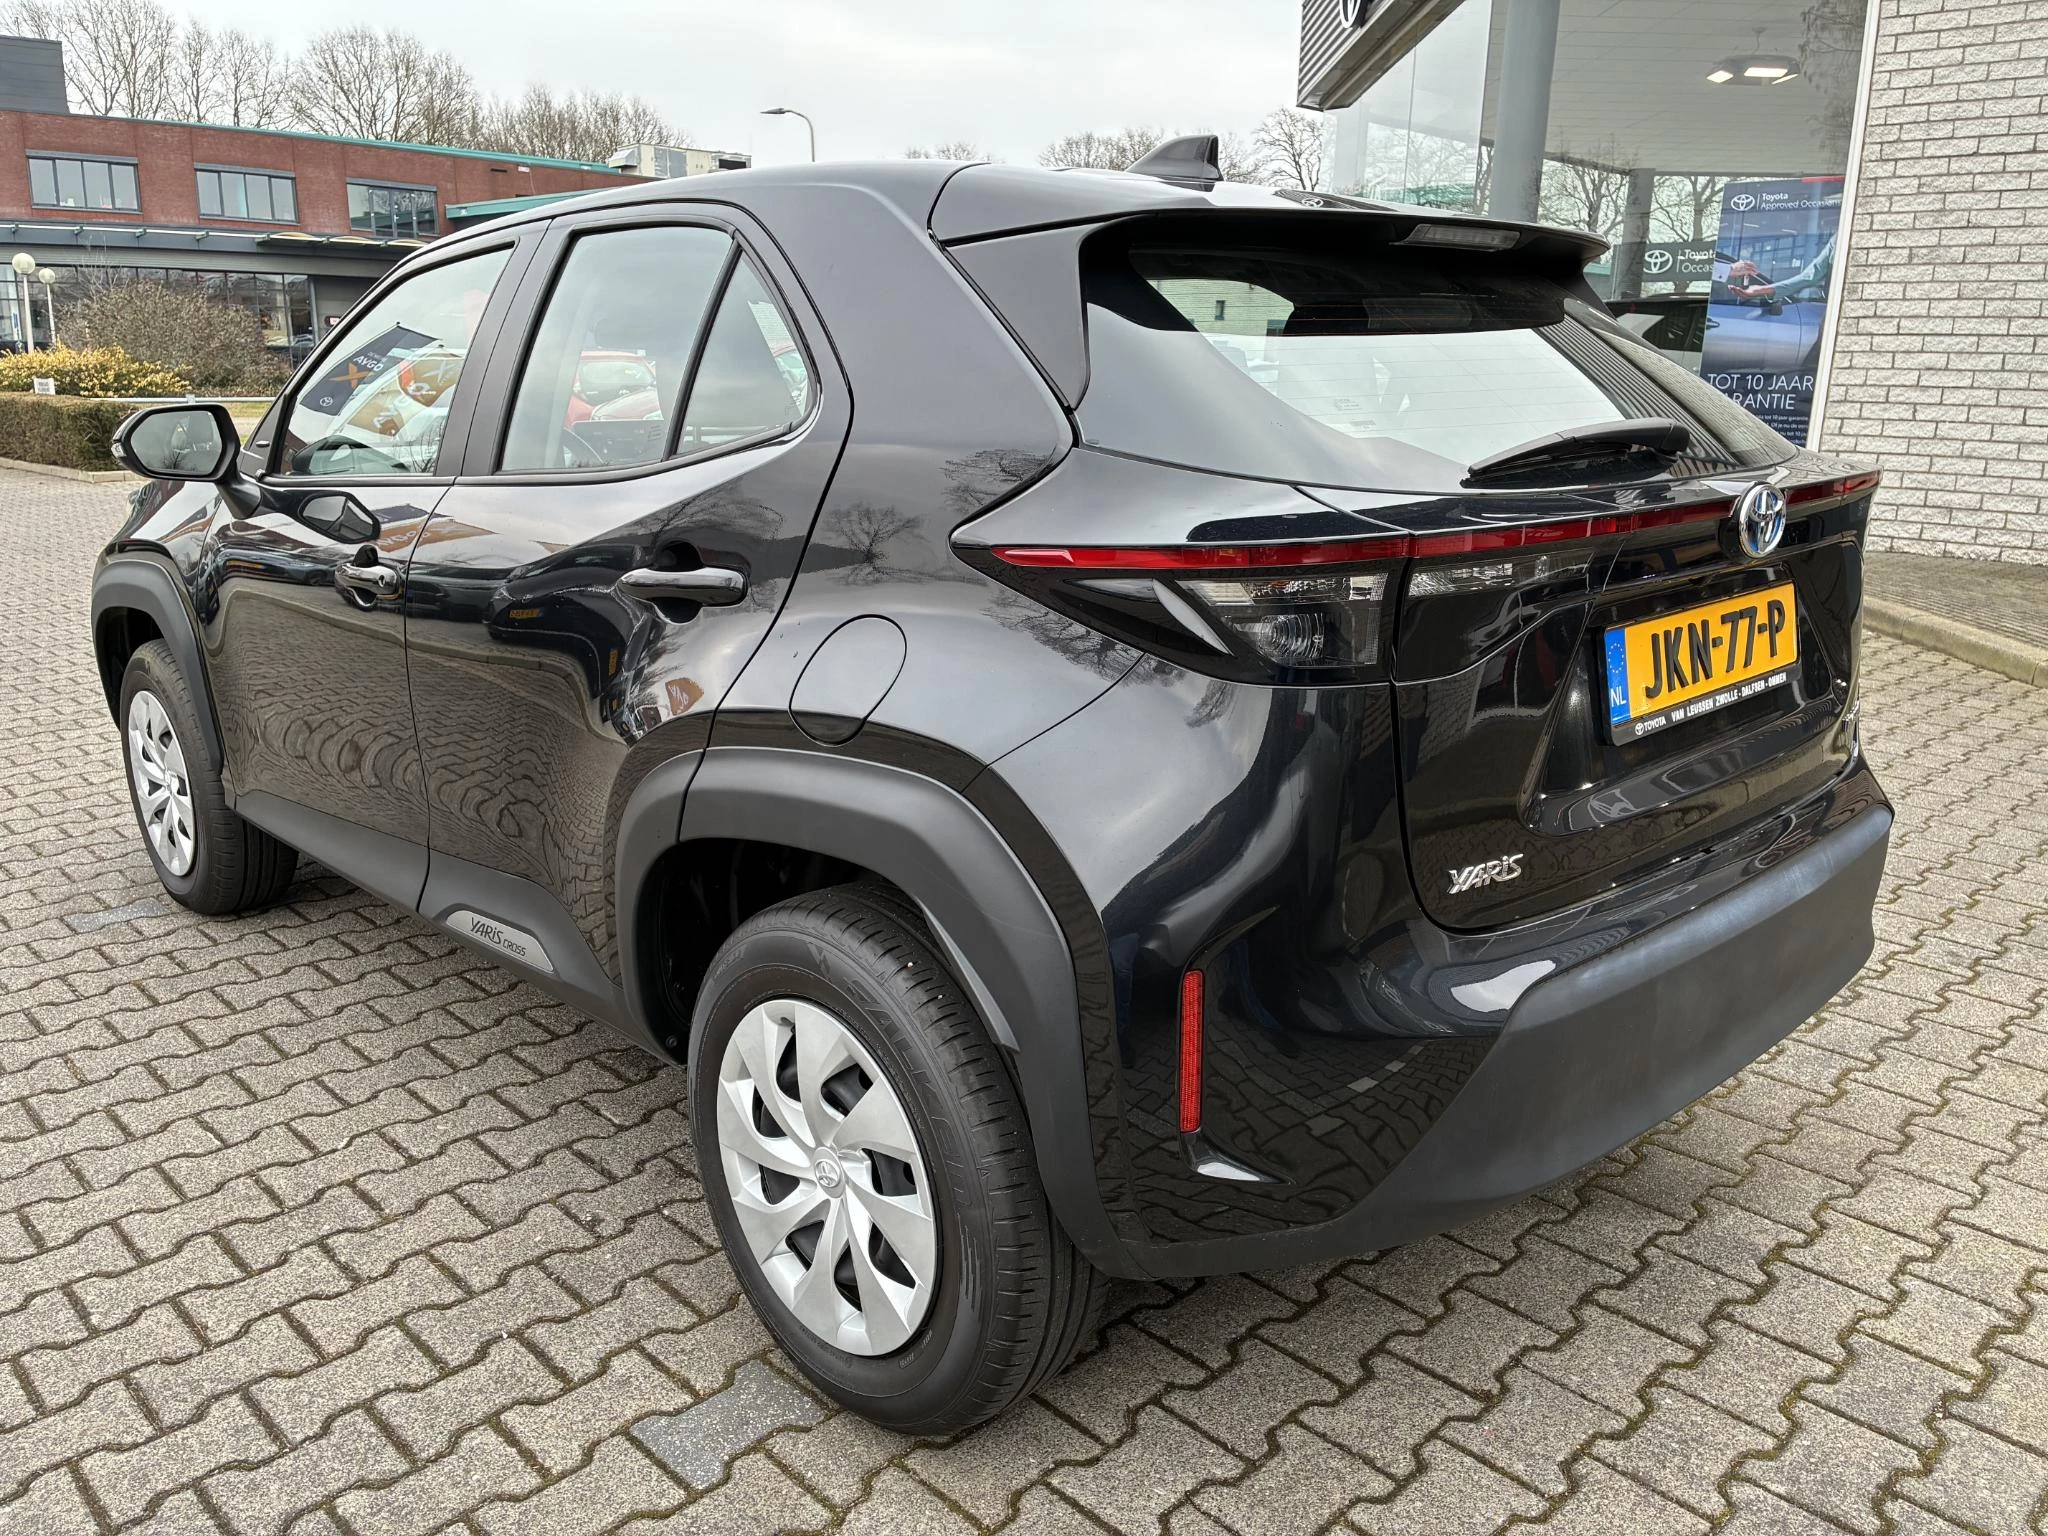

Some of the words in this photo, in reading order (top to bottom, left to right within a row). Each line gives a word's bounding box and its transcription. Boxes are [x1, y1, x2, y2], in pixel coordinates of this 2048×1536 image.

[1760, 201, 1799, 210] Approved
[1762, 192, 1789, 202] Toyota
[353, 355, 384, 372] AYGO
[1707, 373, 1741, 390] TOT
[1746, 374, 1764, 390] 10
[1768, 375, 1814, 391] JAAR
[1645, 599, 1786, 699] JKN-77-P
[1610, 686, 1627, 707] NL
[1644, 716, 1667, 731] TOYOTA
[1671, 708, 1685, 722] VAN
[1686, 699, 1714, 717] LEUSSEN
[502, 939, 527, 957] CROSS
